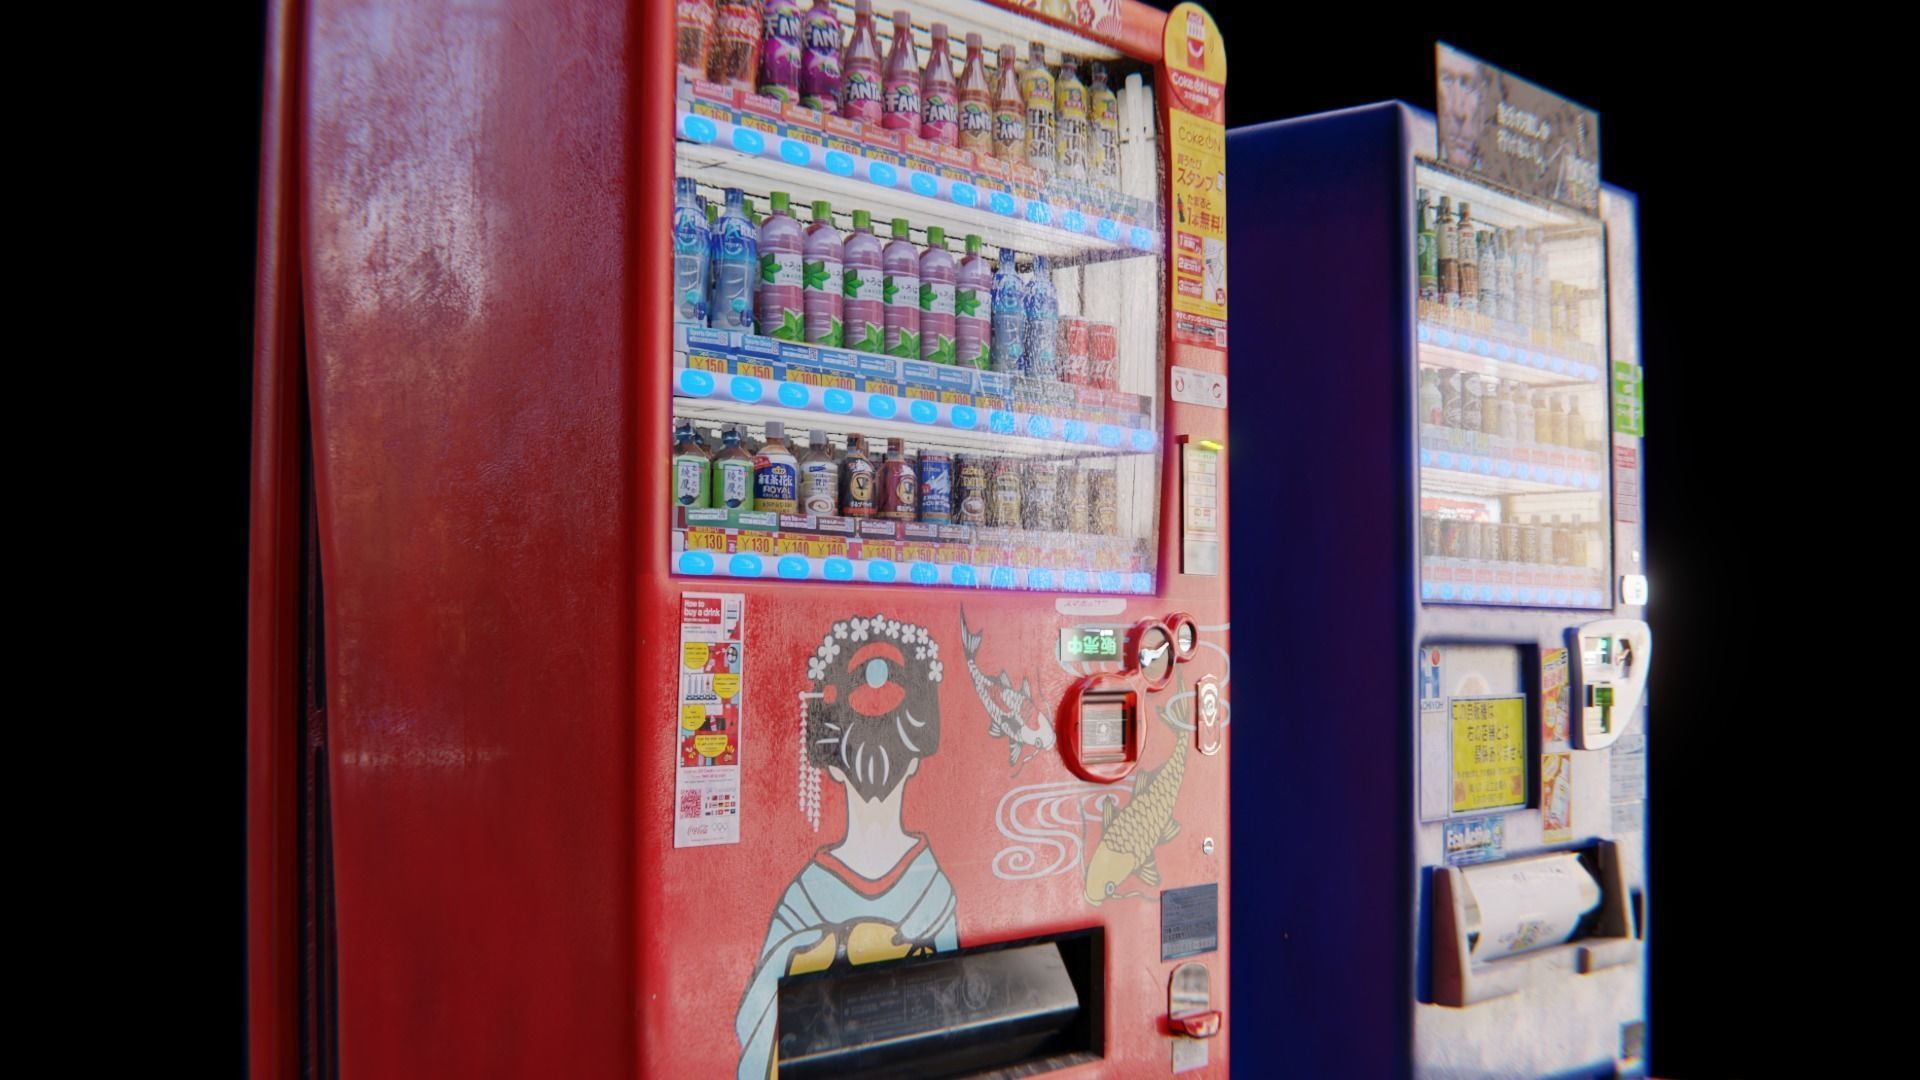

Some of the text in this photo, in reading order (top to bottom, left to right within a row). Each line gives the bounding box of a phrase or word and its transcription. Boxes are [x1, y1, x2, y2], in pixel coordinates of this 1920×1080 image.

[684, 599, 698, 608] How
[684, 608, 698, 617] buy
[703, 607, 721, 617] drink
